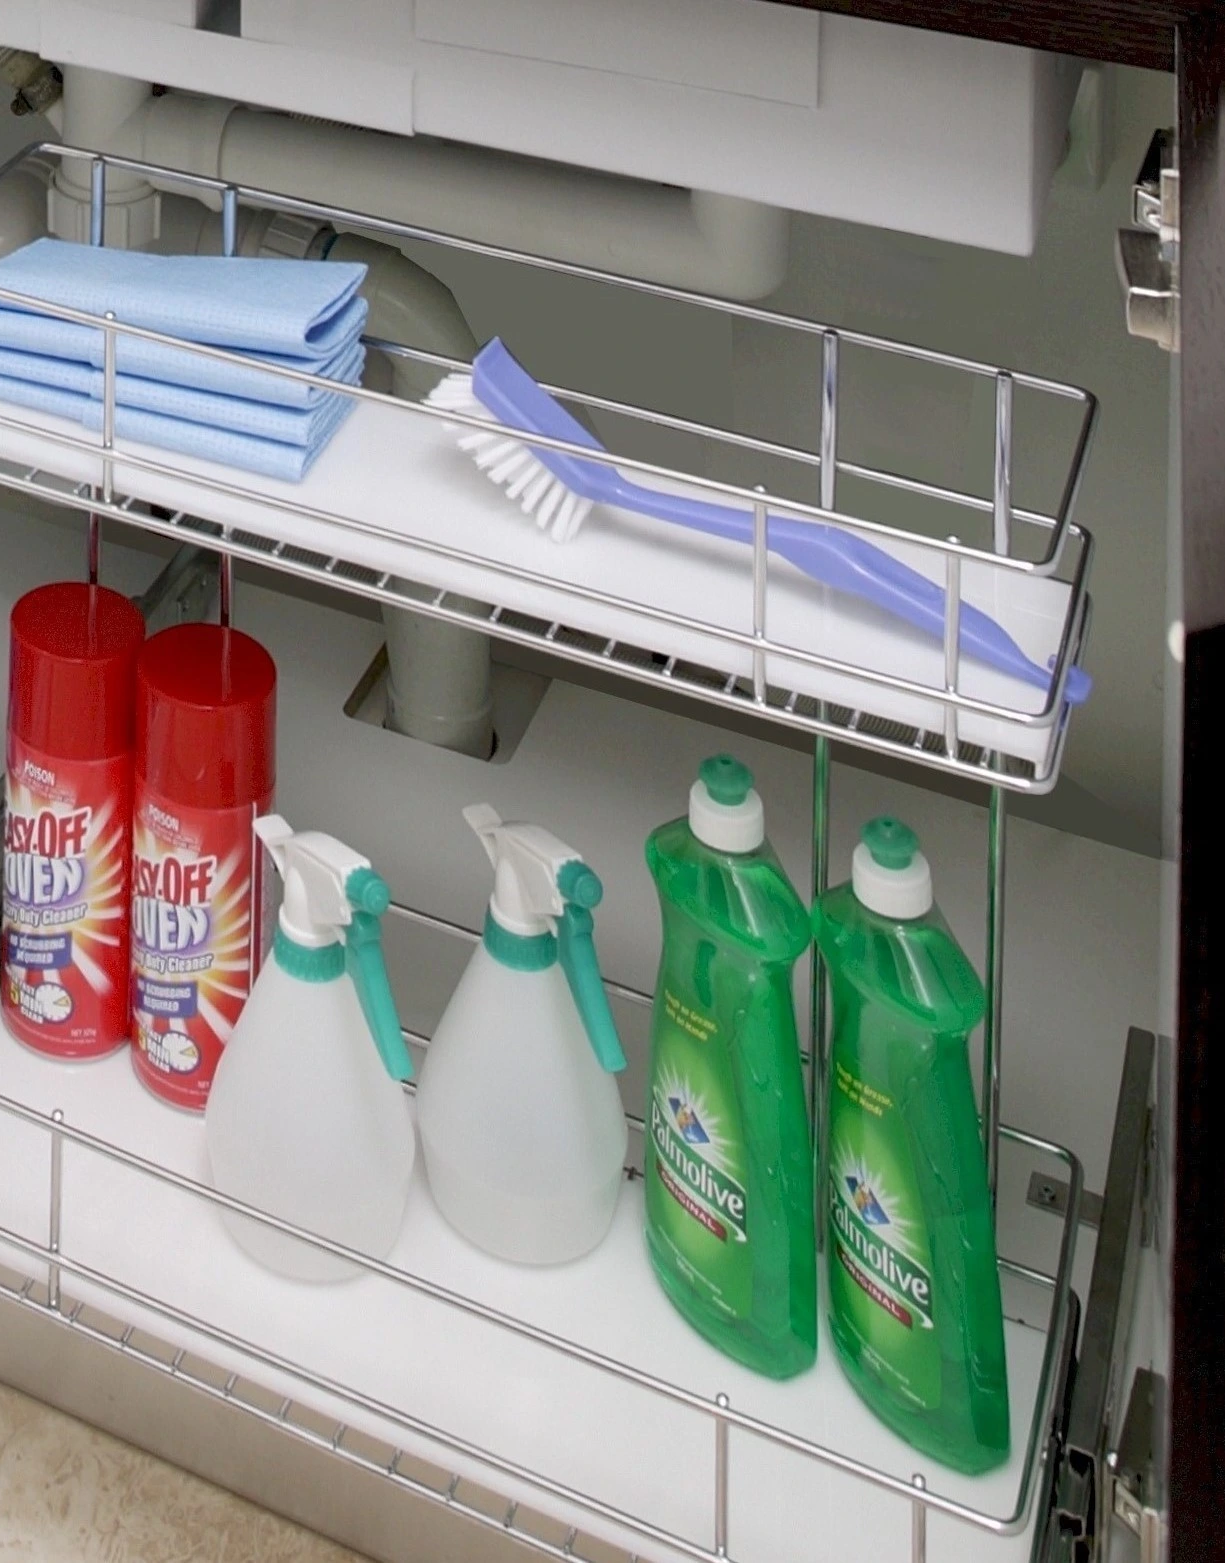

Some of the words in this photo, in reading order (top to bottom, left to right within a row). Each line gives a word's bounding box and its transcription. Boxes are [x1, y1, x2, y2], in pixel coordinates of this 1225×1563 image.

[24, 759, 56, 787] POISON
[5, 854, 85, 904] OVEN
[19, 906, 41, 928] Duty
[41, 903, 88, 926] Cleaner
[132, 898, 209, 951] OVEN
[167, 952, 214, 974] Cleaner
[652, 1100, 745, 1220] Palmolive
[661, 1170, 717, 1232] ORIGINAL
[842, 1252, 902, 1318] ORIGINAL
